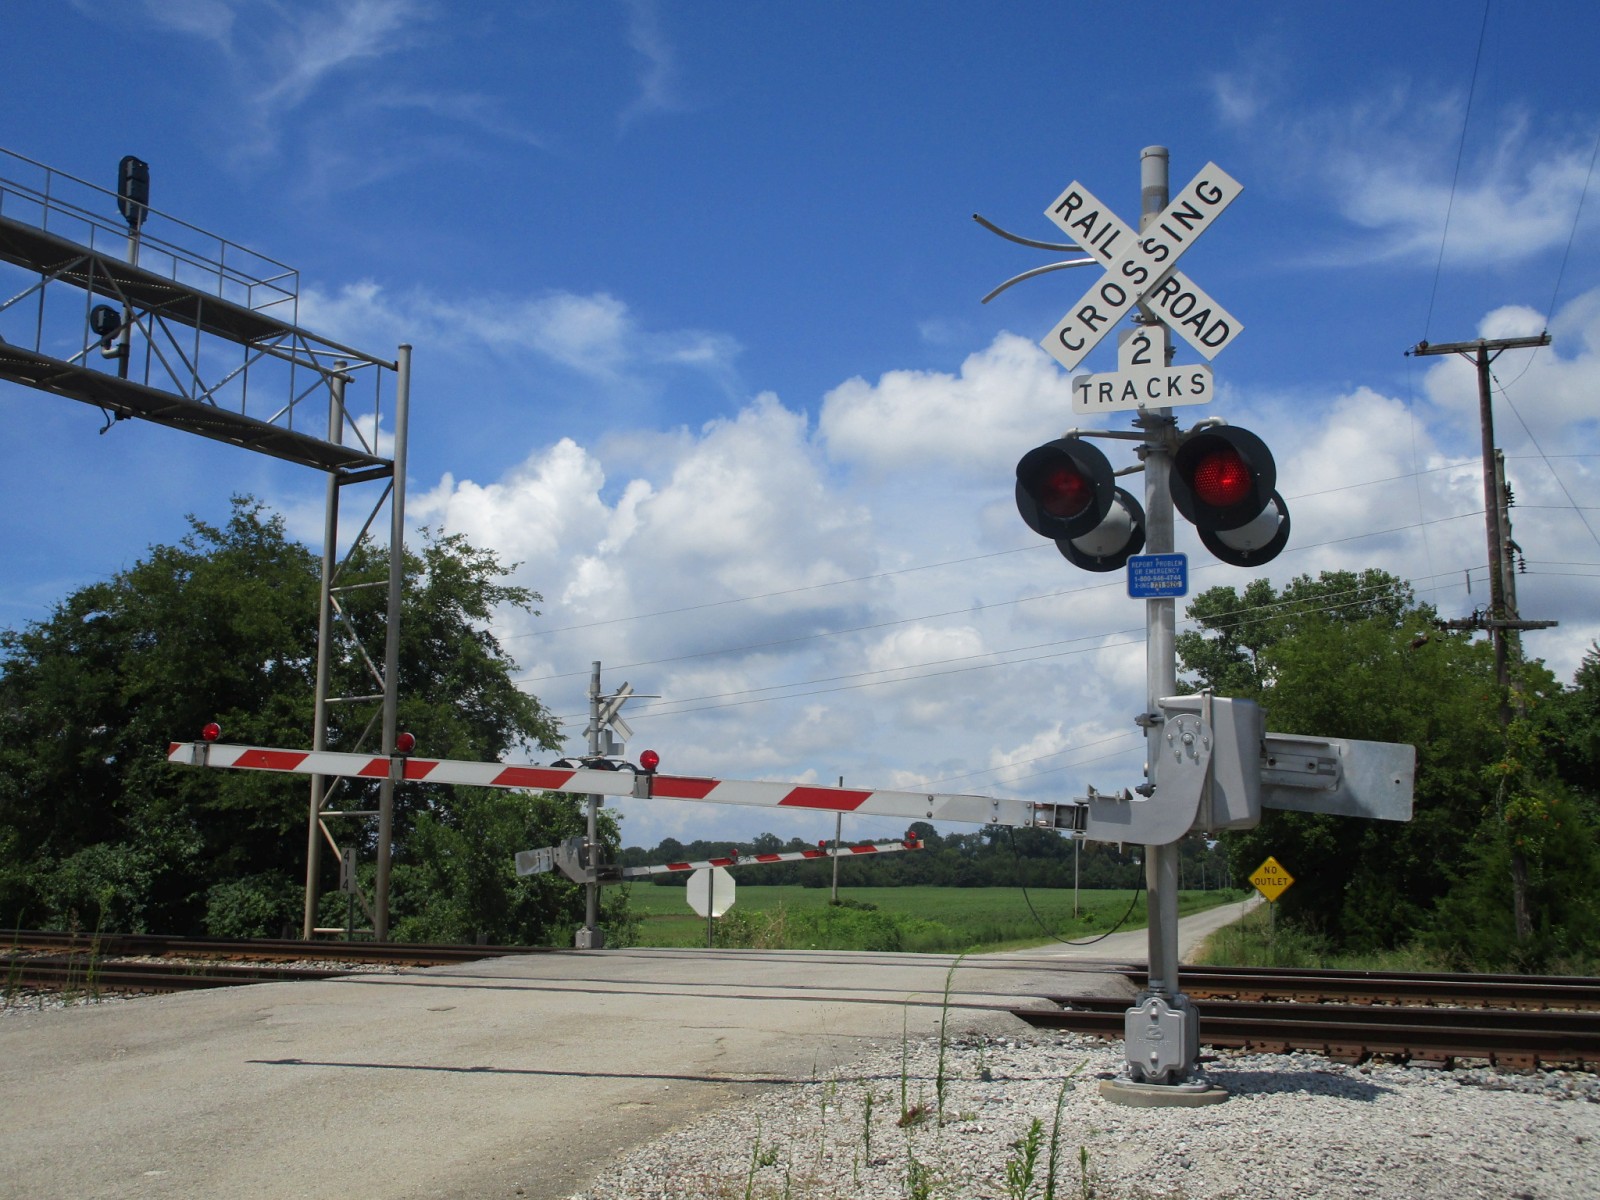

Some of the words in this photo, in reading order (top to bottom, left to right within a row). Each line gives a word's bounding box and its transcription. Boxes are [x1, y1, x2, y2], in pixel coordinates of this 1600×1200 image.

[1055, 191, 1121, 260] RAIL
[1150, 275, 1231, 348] ROAD
[1059, 180, 1223, 352] CROSSING
[1131, 336, 1151, 365] 2
[1079, 373, 1206, 405] TRACKS
[1254, 877, 1288, 886] OUTLET
[1264, 866, 1277, 874] NO
